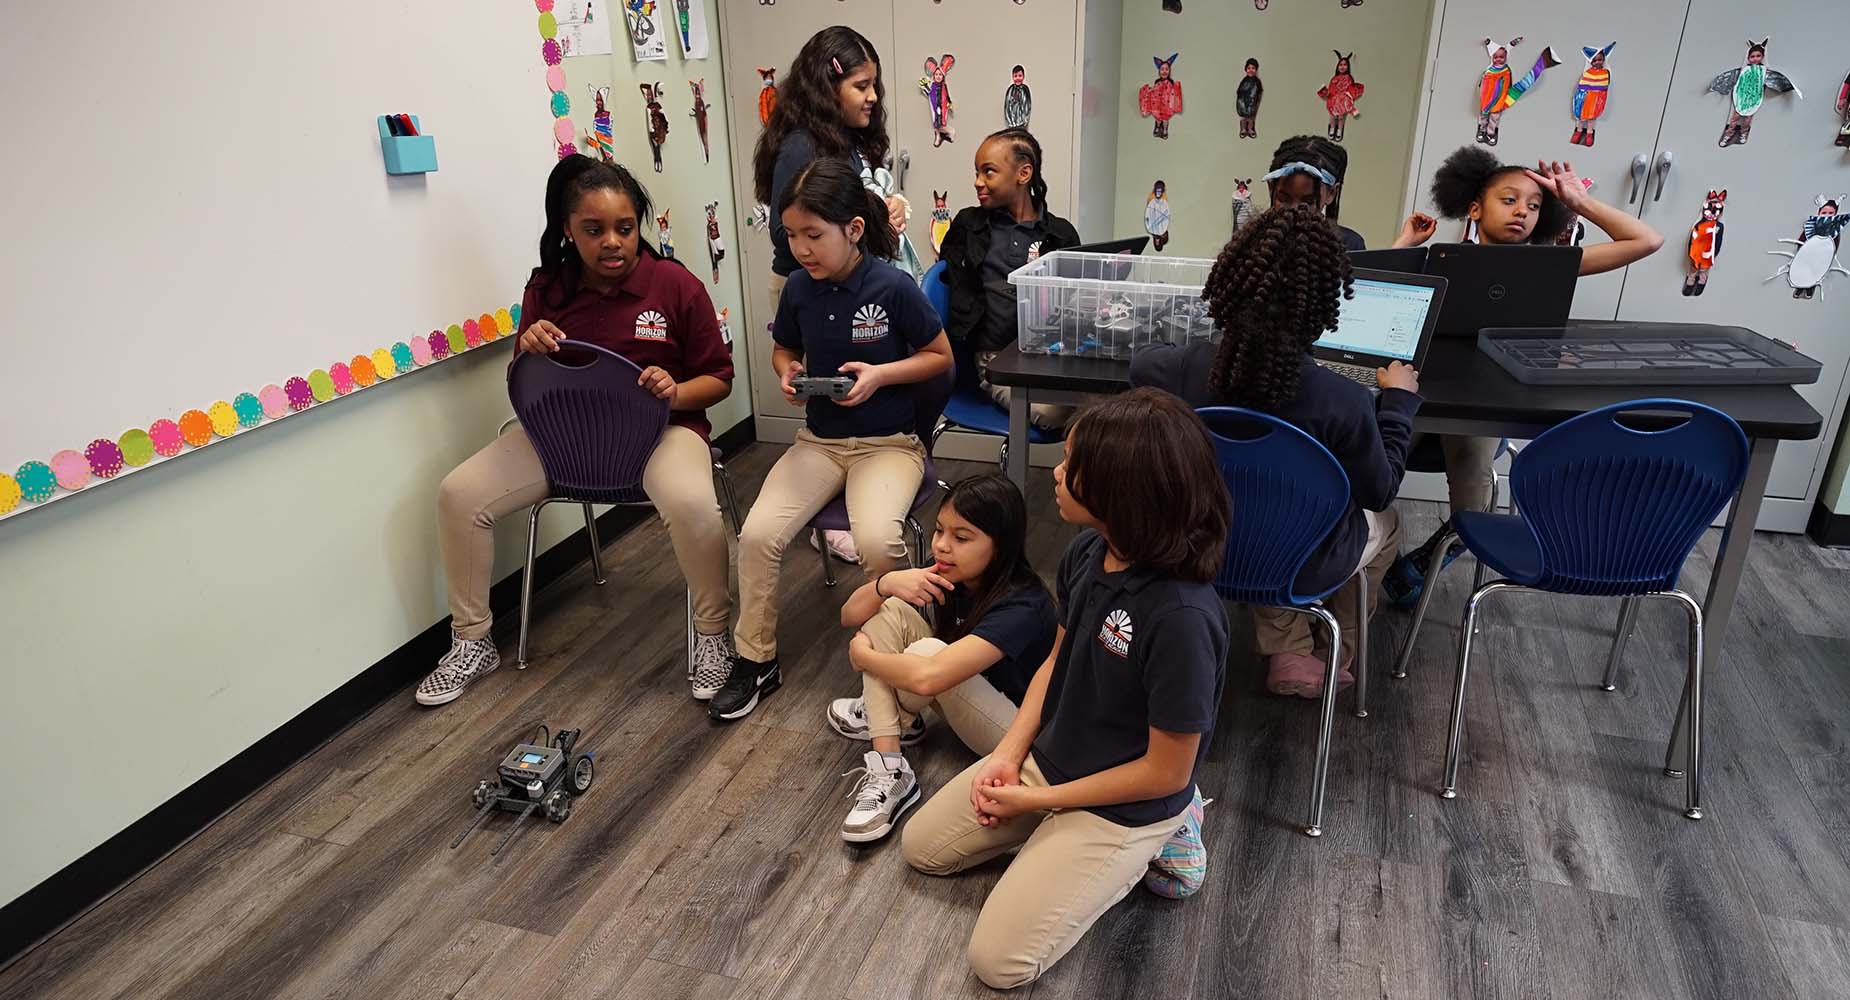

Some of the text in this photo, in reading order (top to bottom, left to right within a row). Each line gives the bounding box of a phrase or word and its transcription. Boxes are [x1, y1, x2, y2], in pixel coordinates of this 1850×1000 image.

[635, 326, 667, 337] HORIZON
[852, 325, 889, 338] HORIZON
[1100, 624, 1129, 653] HORIZON
